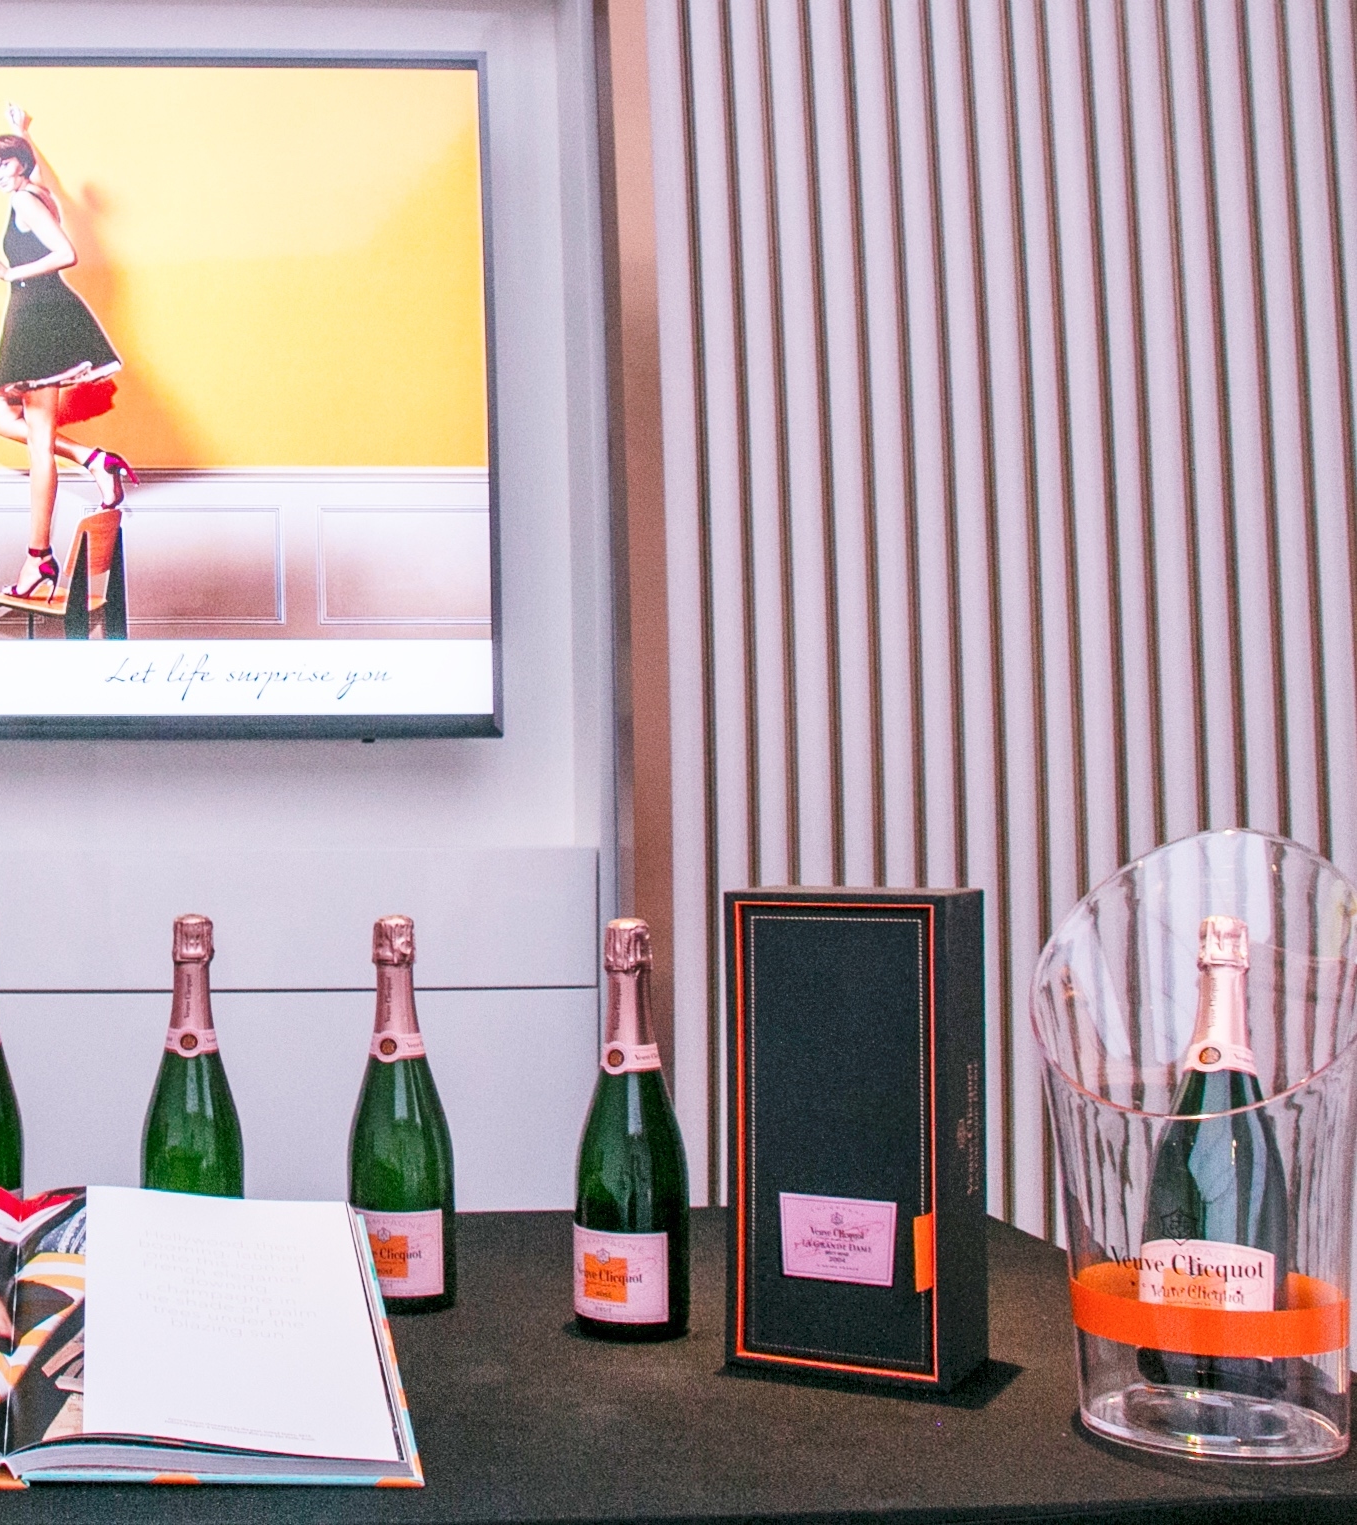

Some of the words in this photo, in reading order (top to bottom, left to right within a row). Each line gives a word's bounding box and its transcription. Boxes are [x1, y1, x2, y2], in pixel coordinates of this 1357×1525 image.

[104, 657, 155, 684] Let
[166, 653, 215, 701] life
[226, 664, 334, 700] surprise
[336, 670, 392, 700] you
[237, 1250, 306, 1264] latched
[256, 1241, 297, 1252] then
[380, 1248, 422, 1262] Clicquot
[143, 1260, 206, 1276] French
[146, 1250, 189, 1263] onto
[197, 1256, 228, 1268] this
[236, 1260, 275, 1272] icon
[283, 1263, 299, 1272] of
[1110, 1245, 1165, 1273] Veuve
[1172, 1254, 1265, 1282] Clicquot
[184, 1277, 267, 1294] downing
[599, 1270, 642, 1286] Clicquot
[138, 1292, 169, 1304] the
[176, 1297, 234, 1312] shade
[242, 1304, 259, 1314] of
[269, 1307, 317, 1319] palm
[157, 1284, 272, 1304] champagne
[280, 1297, 296, 1306] in
[154, 1305, 201, 1319] trees
[208, 1313, 268, 1326] under
[274, 1319, 305, 1329] the
[171, 1318, 243, 1338] blazing
[250, 1329, 284, 1339] sun
